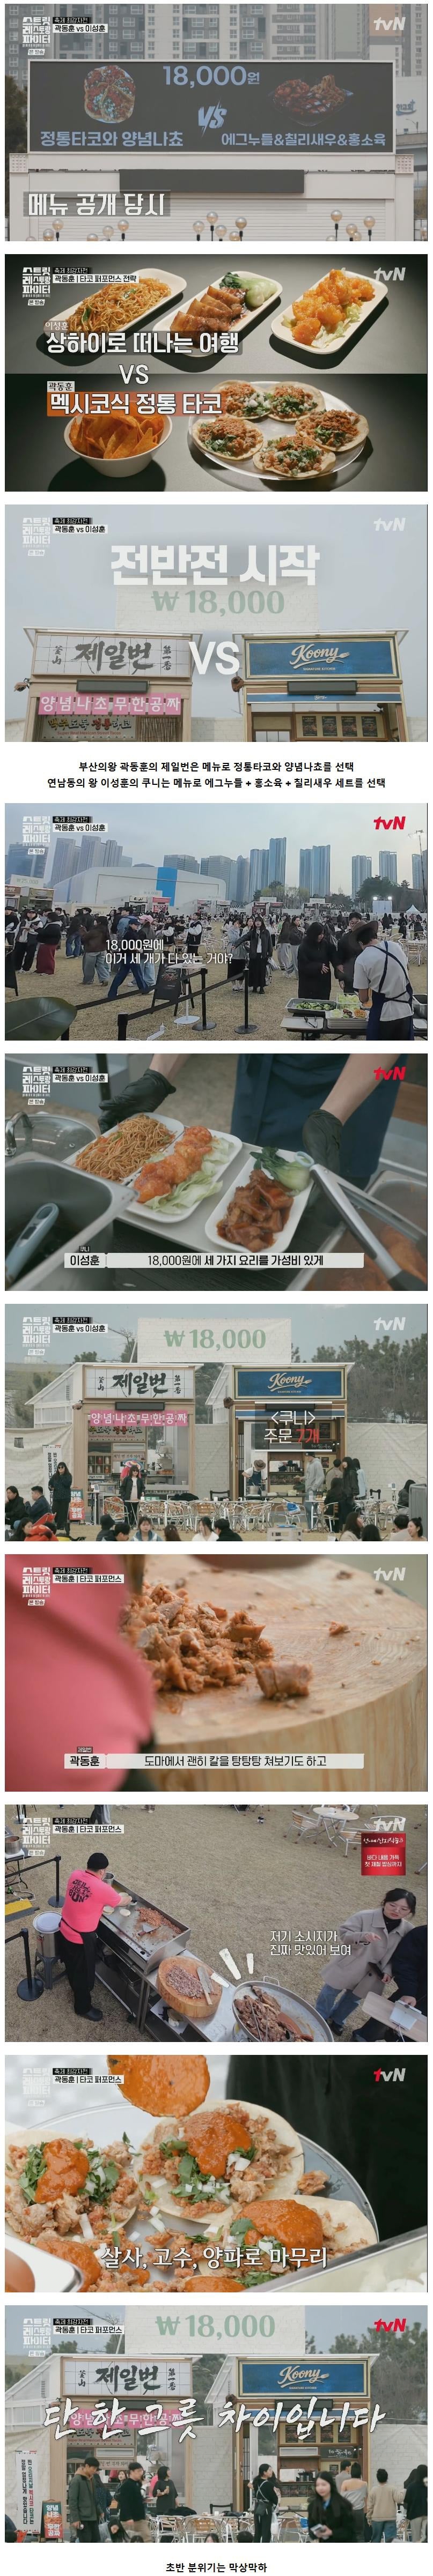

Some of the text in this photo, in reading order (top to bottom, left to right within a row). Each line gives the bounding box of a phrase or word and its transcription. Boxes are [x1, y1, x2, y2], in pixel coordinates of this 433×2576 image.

[163, 65, 260, 88] 18,000원
[40, 131, 184, 147] 정통타코와 양념나쵸
[222, 132, 386, 146] 에그누들&칠리새우&홍소육
[70, 639, 157, 674] 제일번
[289, 643, 348, 665] Koony
[111, 1372, 168, 1397] 제일번
[267, 1372, 311, 1389] Koony
[69, 1889, 85, 1902] BUN
[93, 2365, 163, 2395] 제일번
[277, 2365, 326, 2384] Koony
